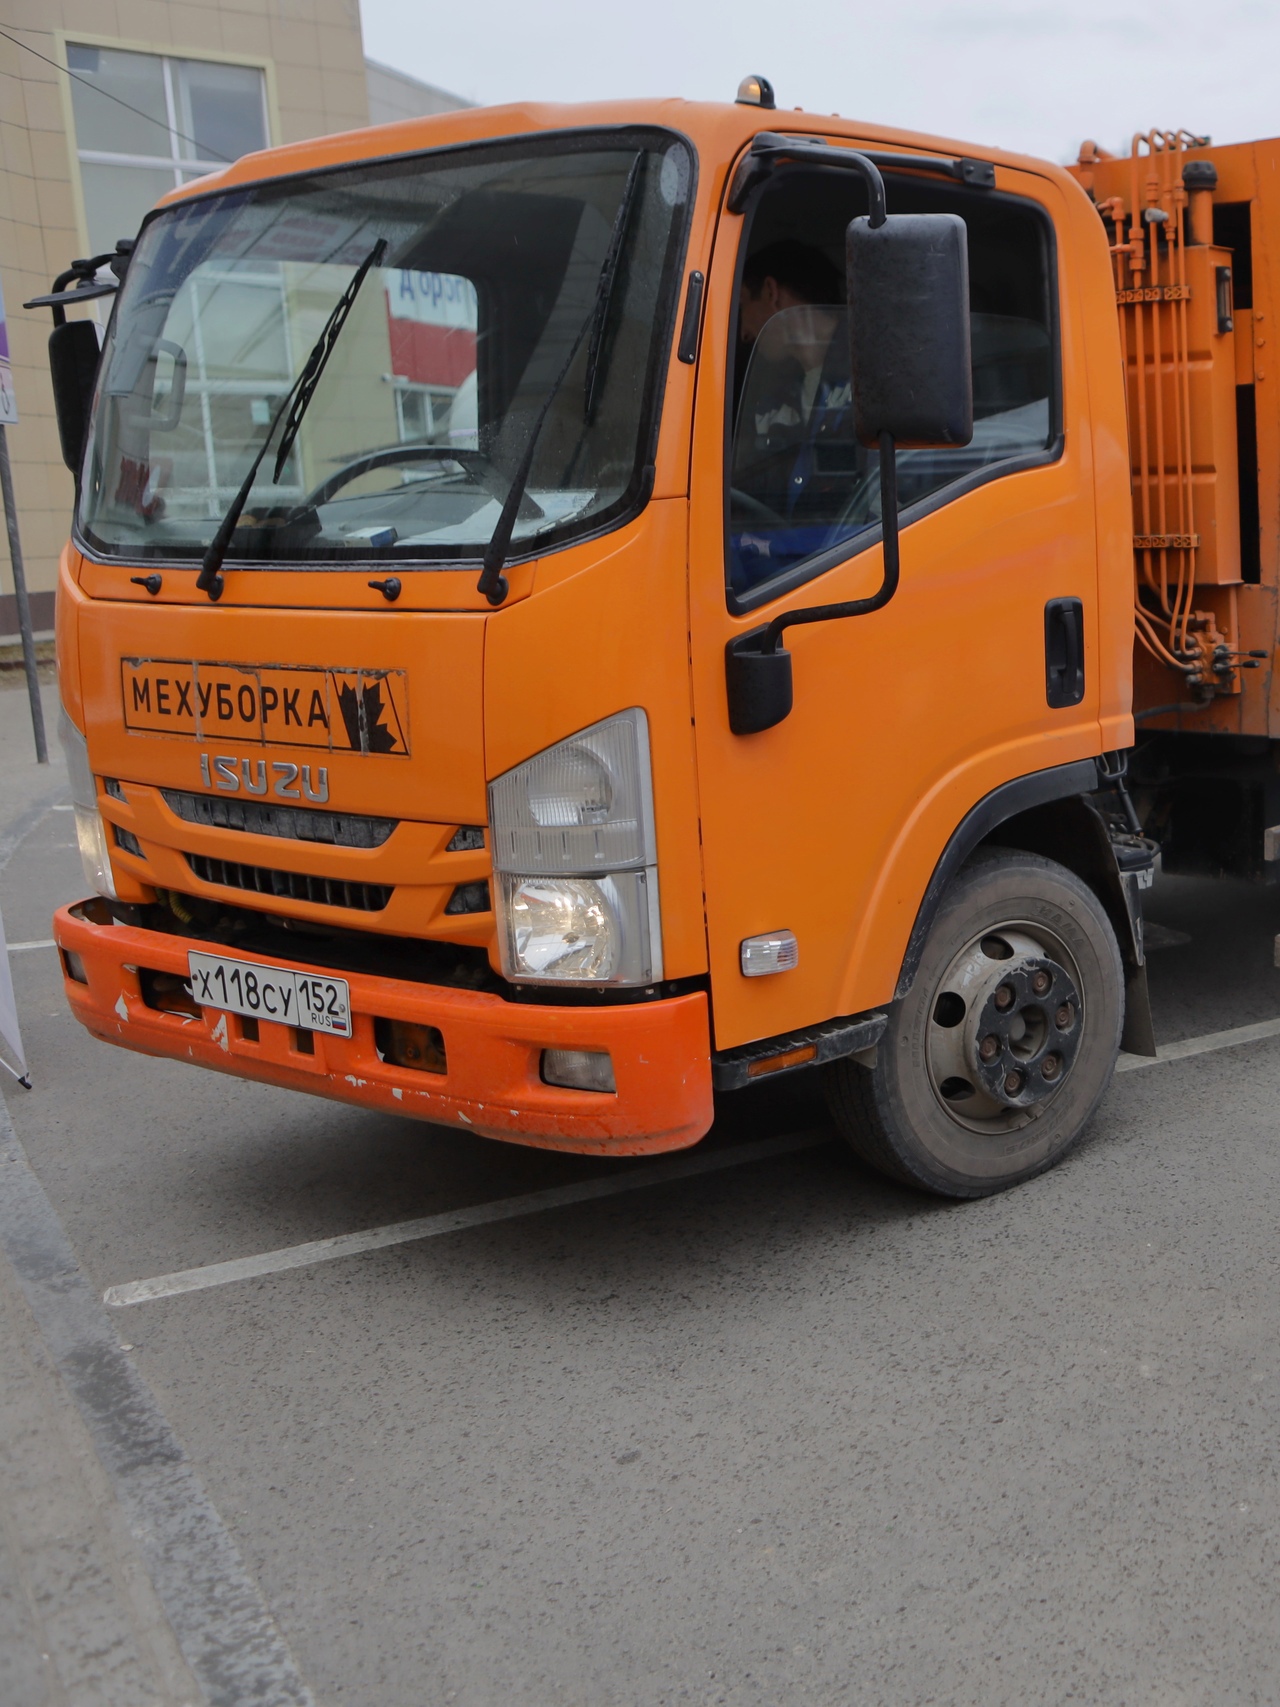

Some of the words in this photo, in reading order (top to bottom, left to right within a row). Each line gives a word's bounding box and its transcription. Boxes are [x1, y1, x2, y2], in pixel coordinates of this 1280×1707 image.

[132, 677, 330, 728] МЕХУБОРКА
[201, 753, 329, 803] ISUZU
[299, 980, 339, 1016] 152
[311, 1013, 331, 1027] RUS
